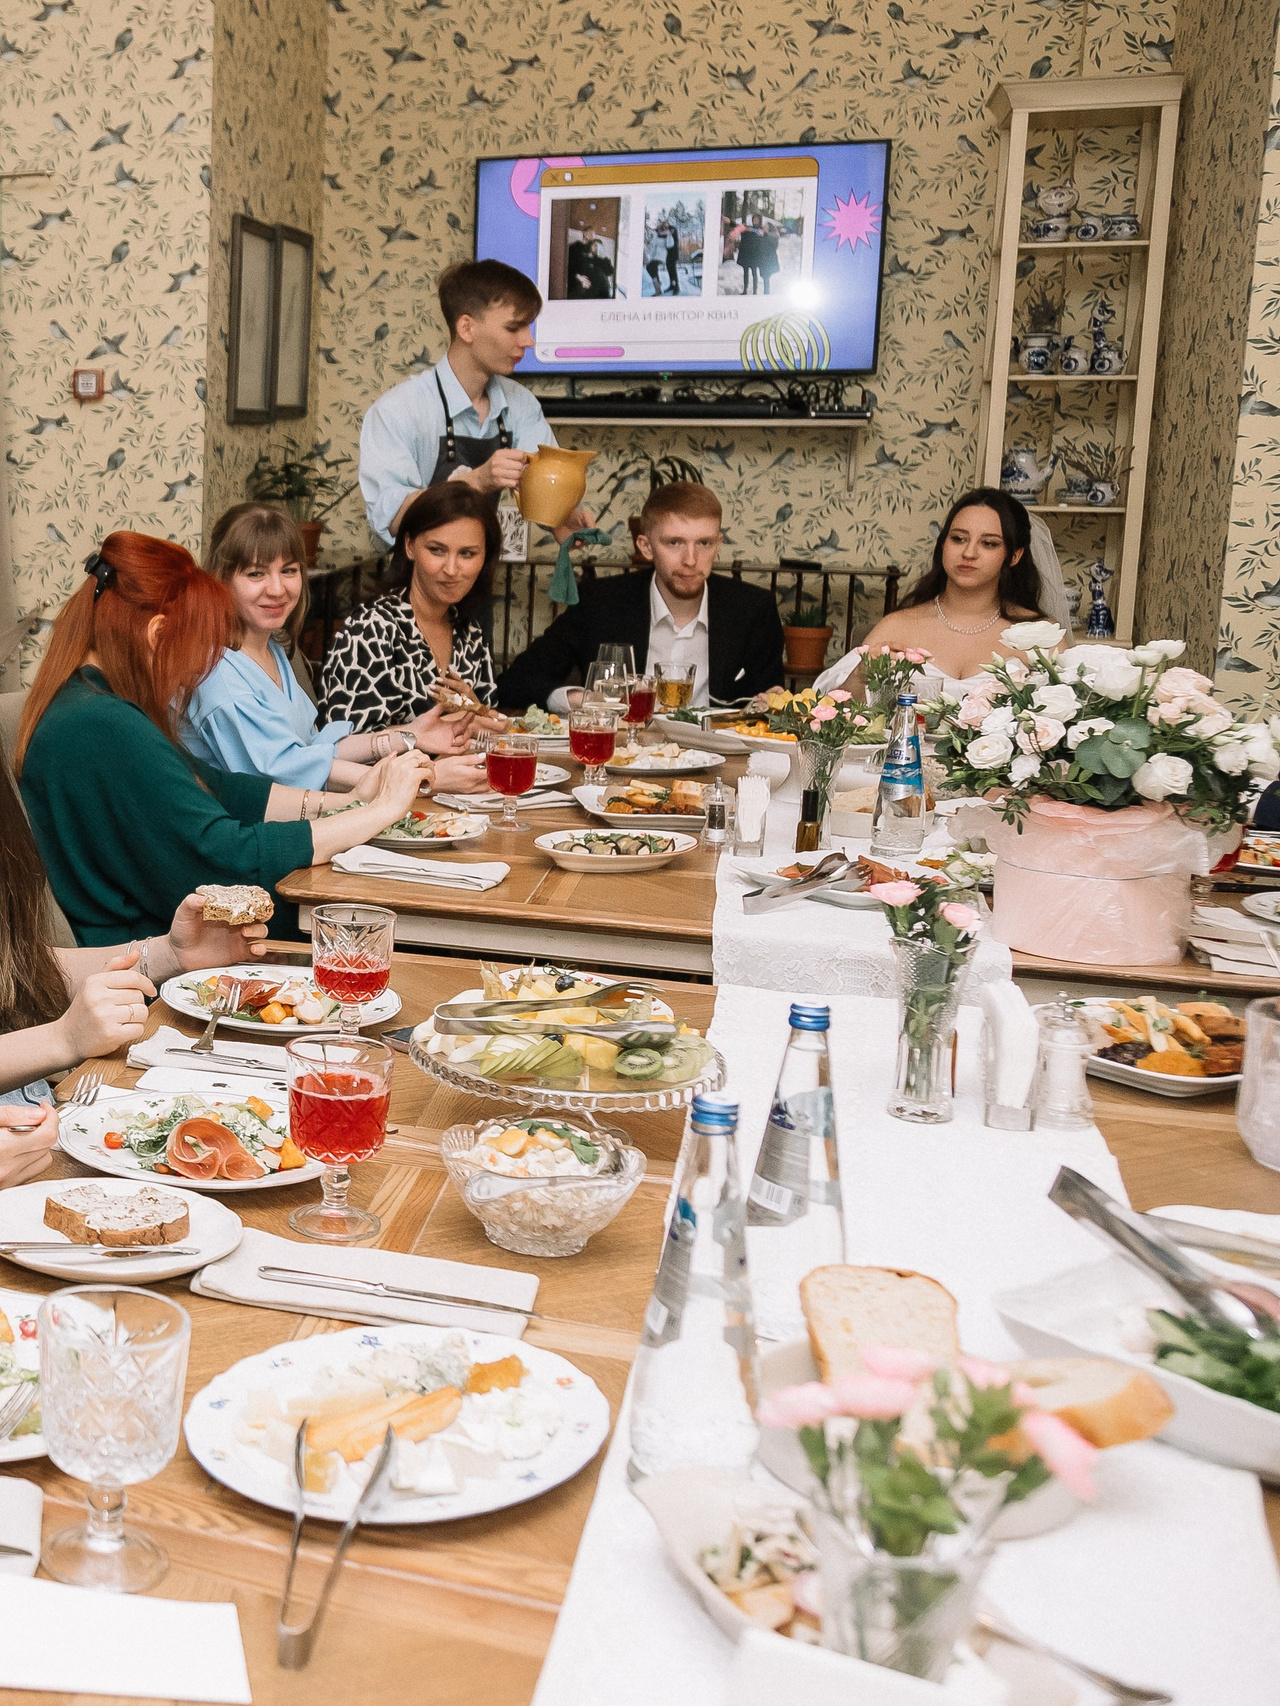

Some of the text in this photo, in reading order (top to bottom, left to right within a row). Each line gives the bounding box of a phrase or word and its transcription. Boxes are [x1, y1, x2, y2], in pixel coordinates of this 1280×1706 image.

[601, 309, 739, 322] ЕЛЕНА И ВИКТОР КВИЗ
